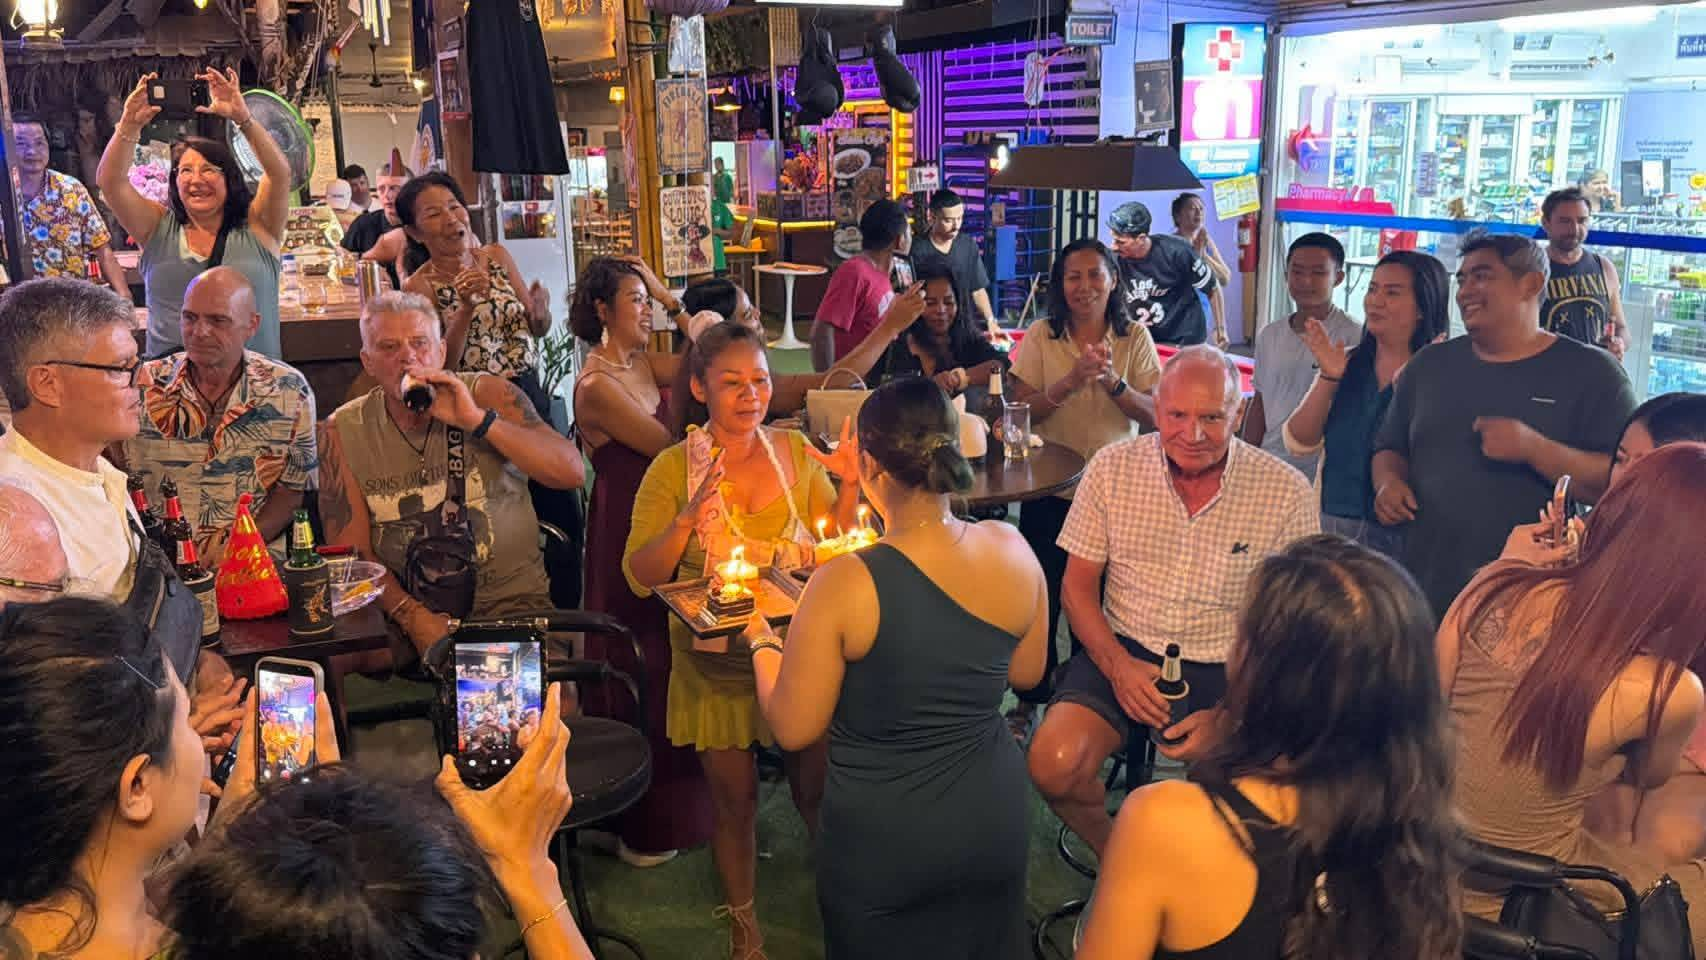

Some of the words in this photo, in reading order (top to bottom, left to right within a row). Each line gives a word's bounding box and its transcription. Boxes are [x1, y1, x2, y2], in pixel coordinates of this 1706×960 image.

[1071, 22, 1112, 37] TOILET
[1549, 274, 1607, 298] IRVANA
[1136, 302, 1165, 326] 23
